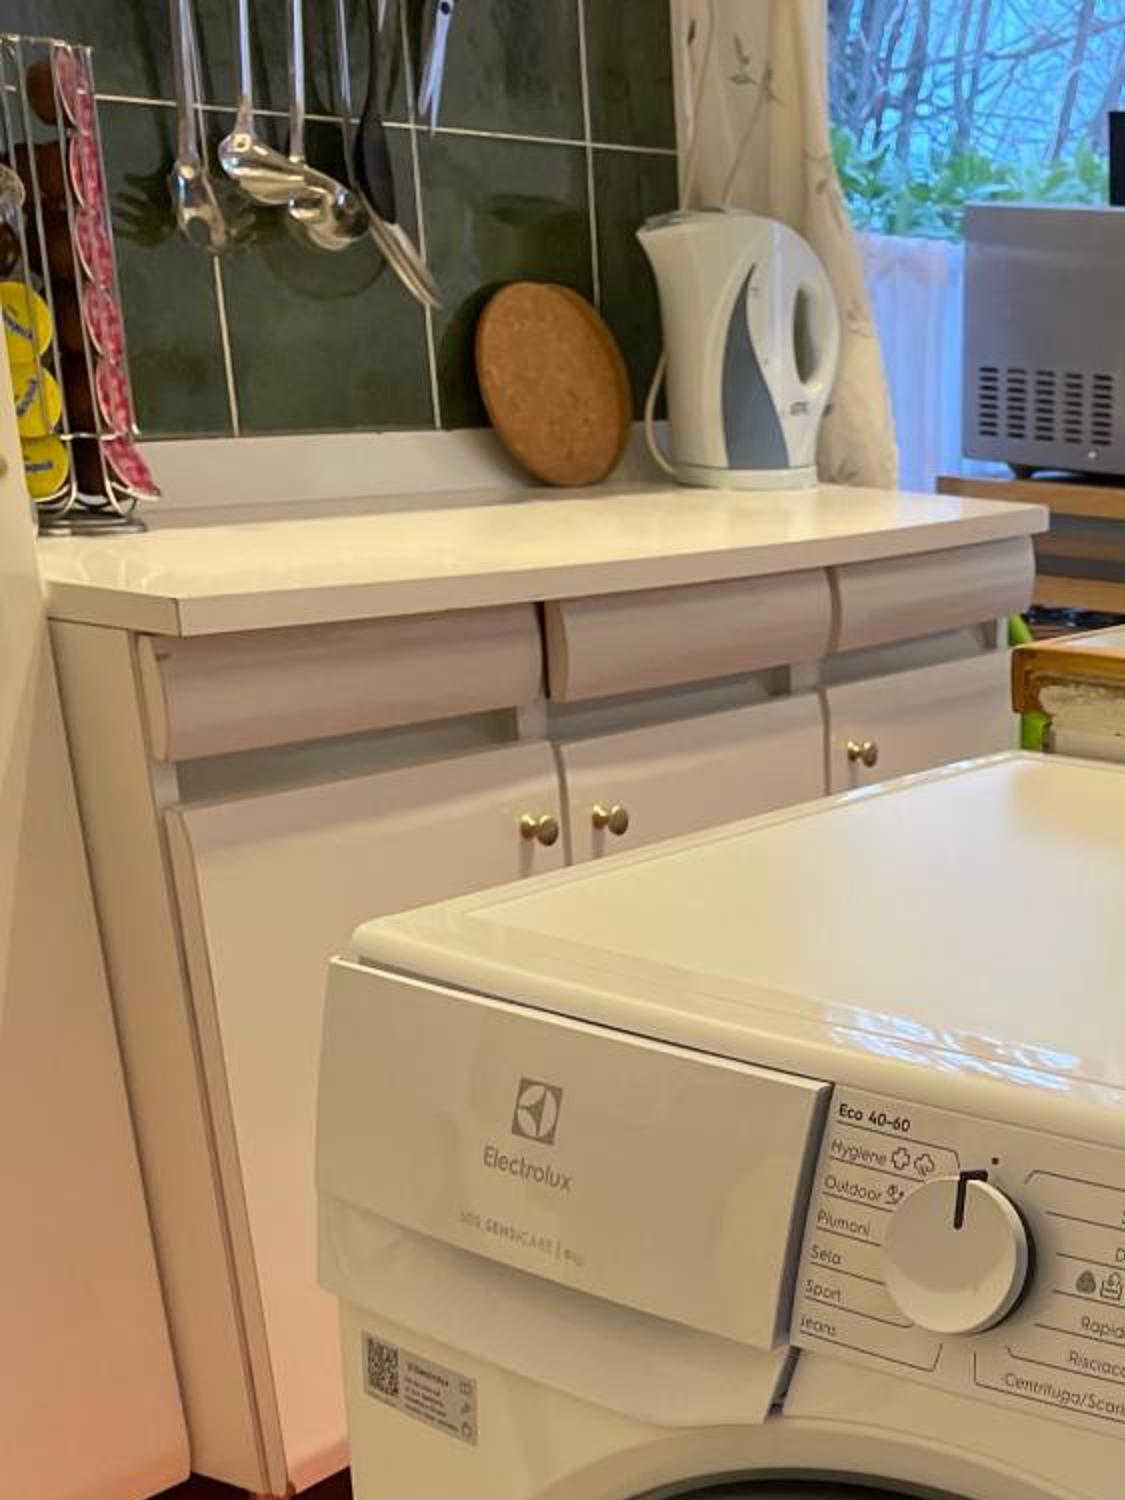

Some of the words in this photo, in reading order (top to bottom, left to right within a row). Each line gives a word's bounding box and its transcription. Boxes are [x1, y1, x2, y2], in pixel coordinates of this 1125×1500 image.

[839, 1103, 863, 1121] Eco
[868, 1111, 911, 1132] 40-60
[831, 1138, 887, 1165] Hygiene
[483, 1145, 572, 1193] Electrolux
[824, 1174, 882, 1201] Outdoor
[805, 1279, 842, 1303] Sport
